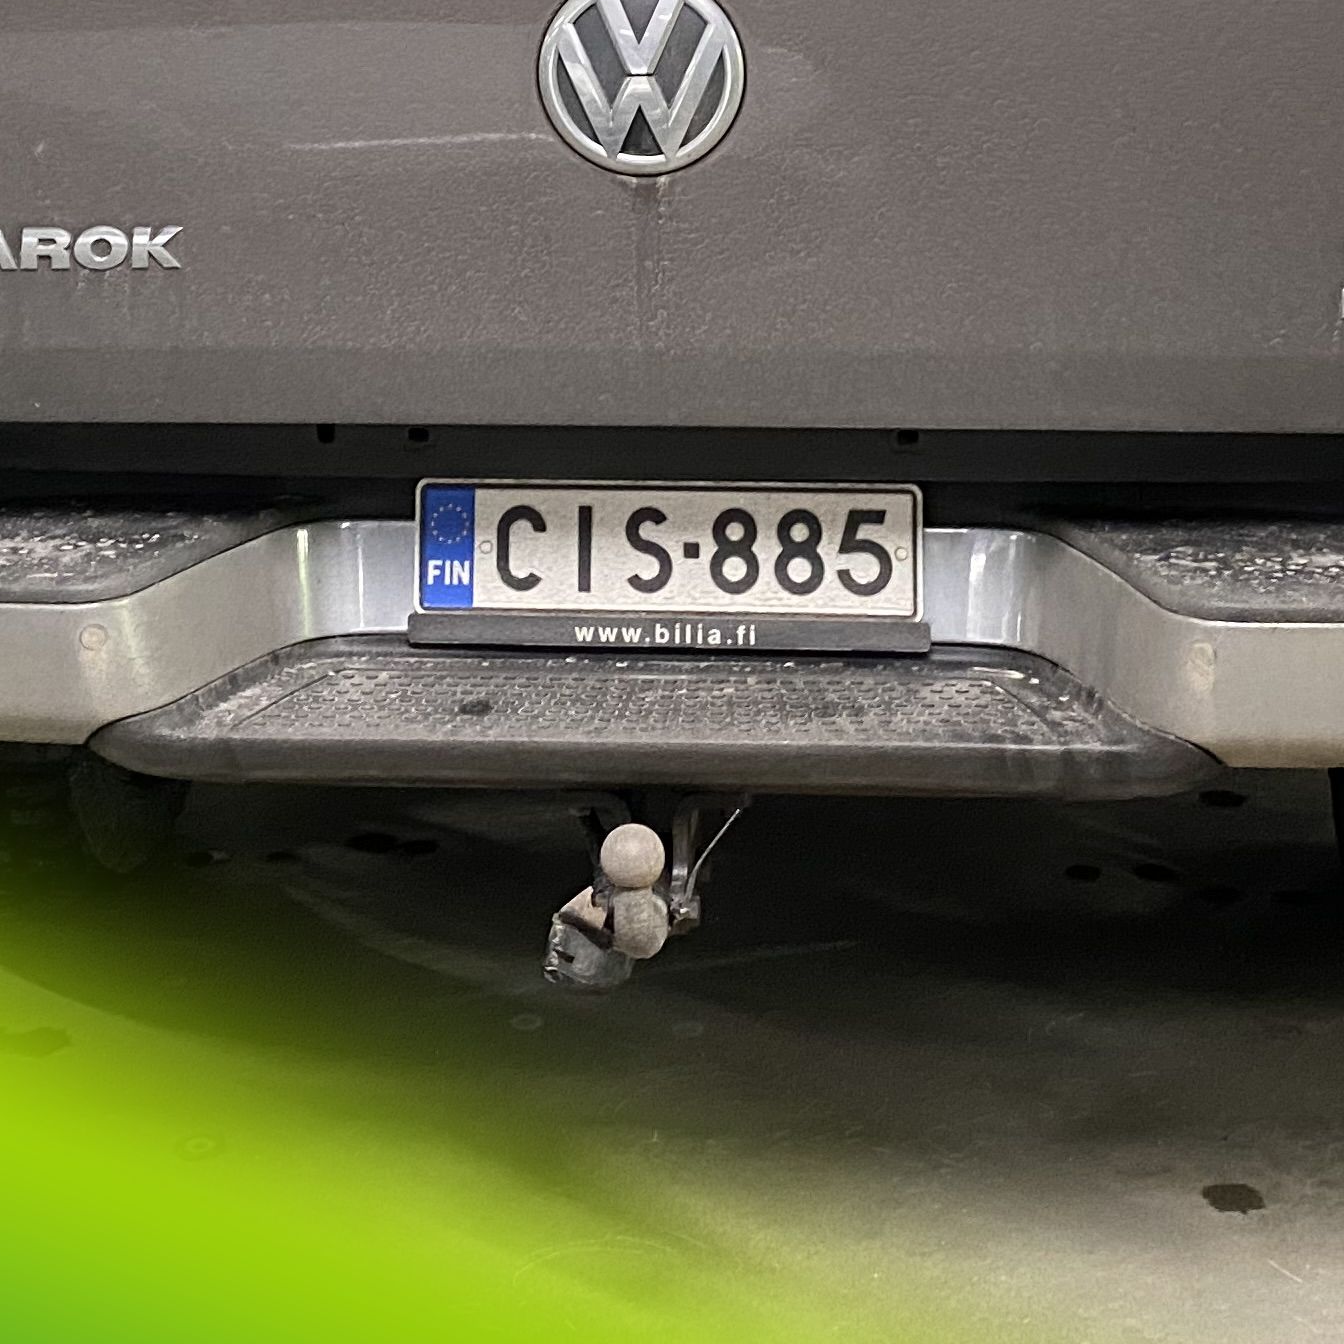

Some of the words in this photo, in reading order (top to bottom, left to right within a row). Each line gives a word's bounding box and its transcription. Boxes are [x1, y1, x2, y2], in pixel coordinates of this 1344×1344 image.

[495, 504, 893, 597] CIS-885
[426, 559, 471, 586] FIN
[573, 623, 757, 647] www.bilia.fi
